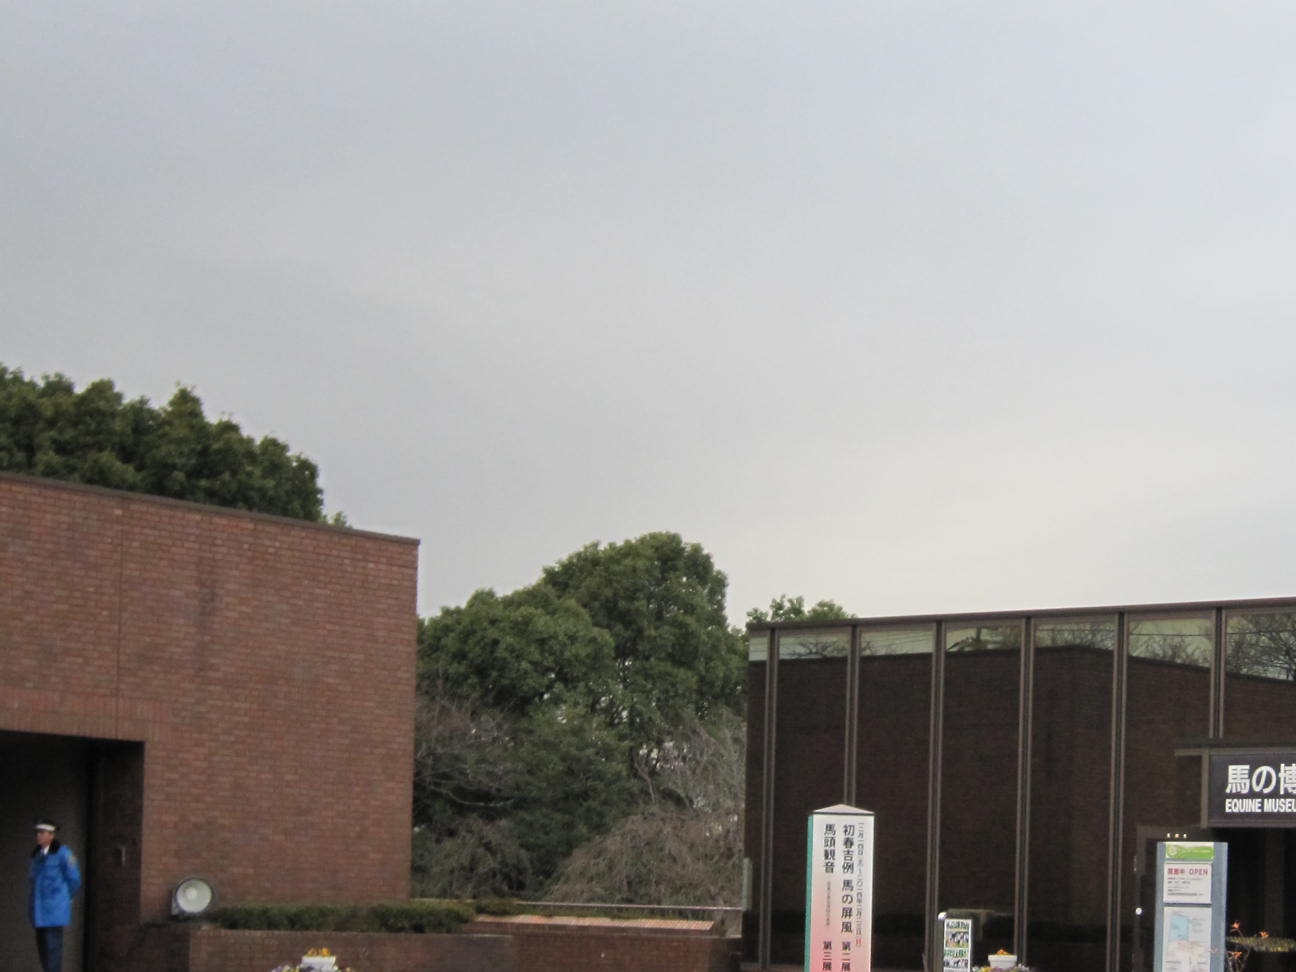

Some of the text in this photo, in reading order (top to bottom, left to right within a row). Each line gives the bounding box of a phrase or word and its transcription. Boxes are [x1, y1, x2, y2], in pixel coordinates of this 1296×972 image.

[1225, 798, 1262, 812] EQUINE
[824, 824, 836, 874] 馬頭観音
[842, 824, 855, 874] 初春吉例
[1188, 868, 1209, 876] OPEN
[841, 879, 853, 933] 馬の屏風
